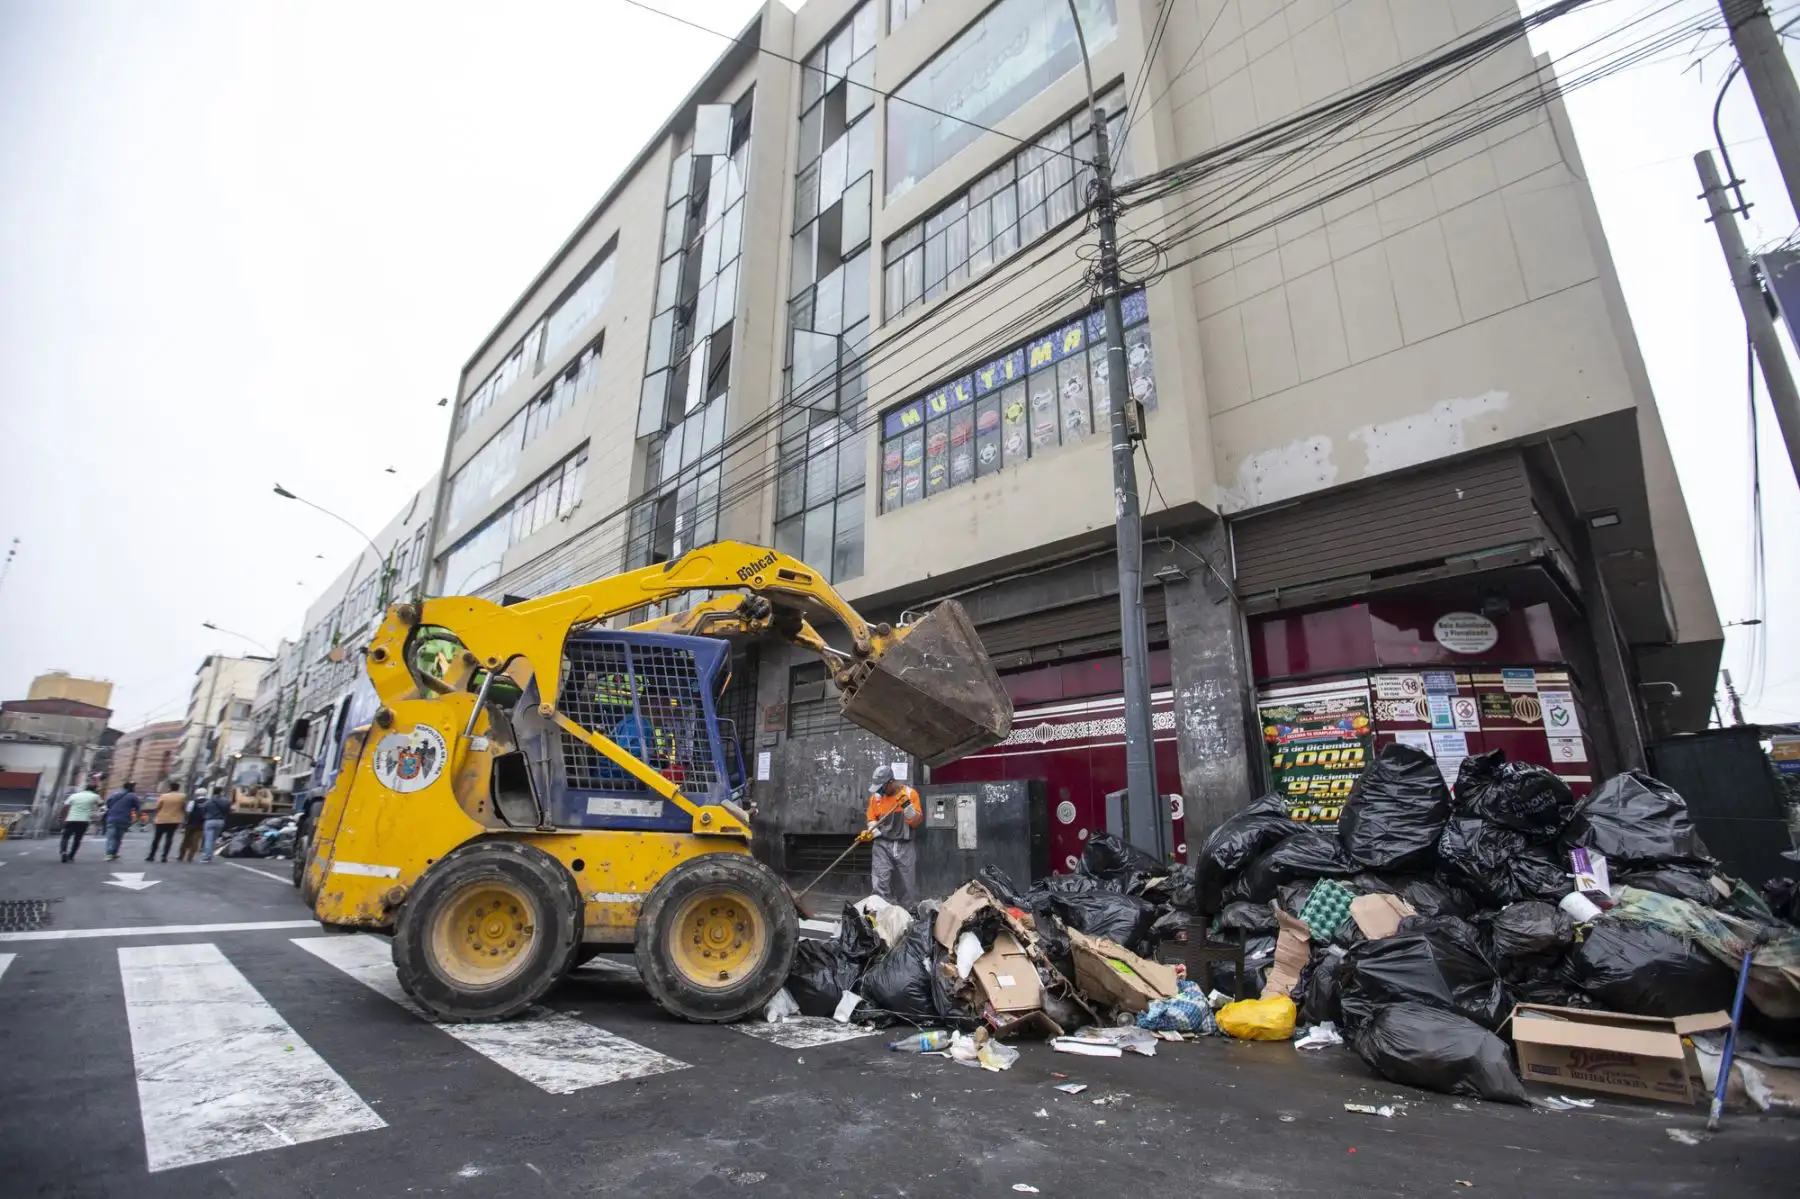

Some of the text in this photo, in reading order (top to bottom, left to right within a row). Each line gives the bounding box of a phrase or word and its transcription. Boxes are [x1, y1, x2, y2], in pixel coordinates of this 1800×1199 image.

[901, 327, 1106, 428] MULTIMA
[736, 551, 778, 581] Bobcat
[1306, 742, 1361, 751] Diciembre
[1272, 748, 1364, 769] 1,000
[1287, 779, 1354, 795] 950
